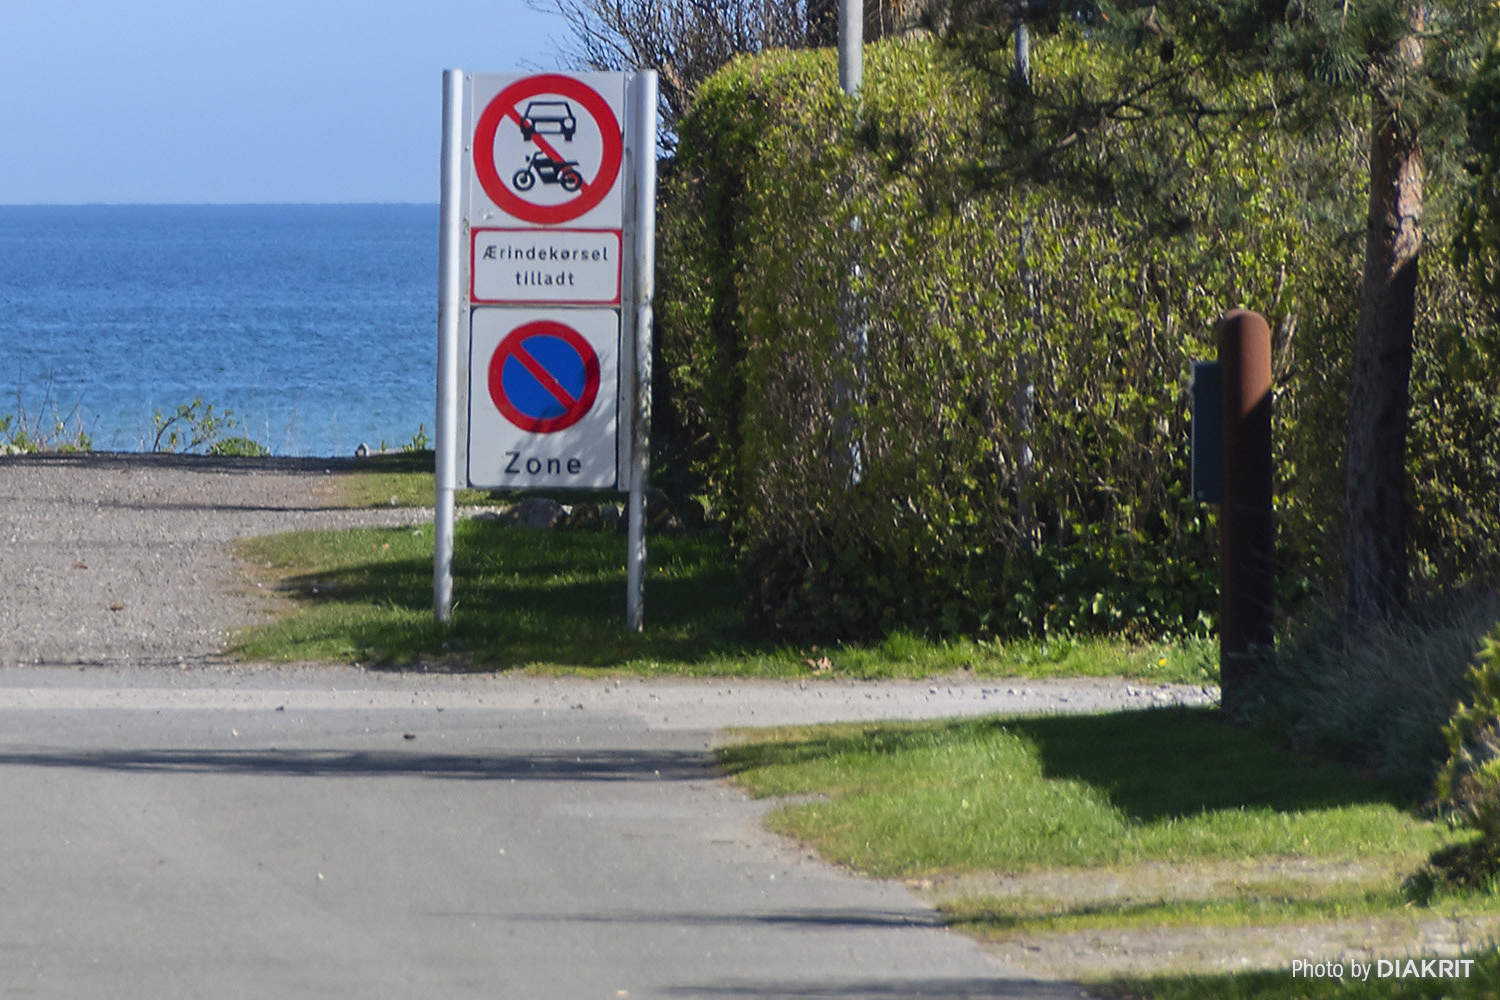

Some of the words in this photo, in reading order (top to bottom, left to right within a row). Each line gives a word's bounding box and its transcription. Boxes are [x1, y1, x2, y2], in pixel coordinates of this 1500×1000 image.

[482, 245, 608, 262] Ærindekørsel
[515, 271, 575, 286] tilladt
[504, 451, 582, 475] Zone
